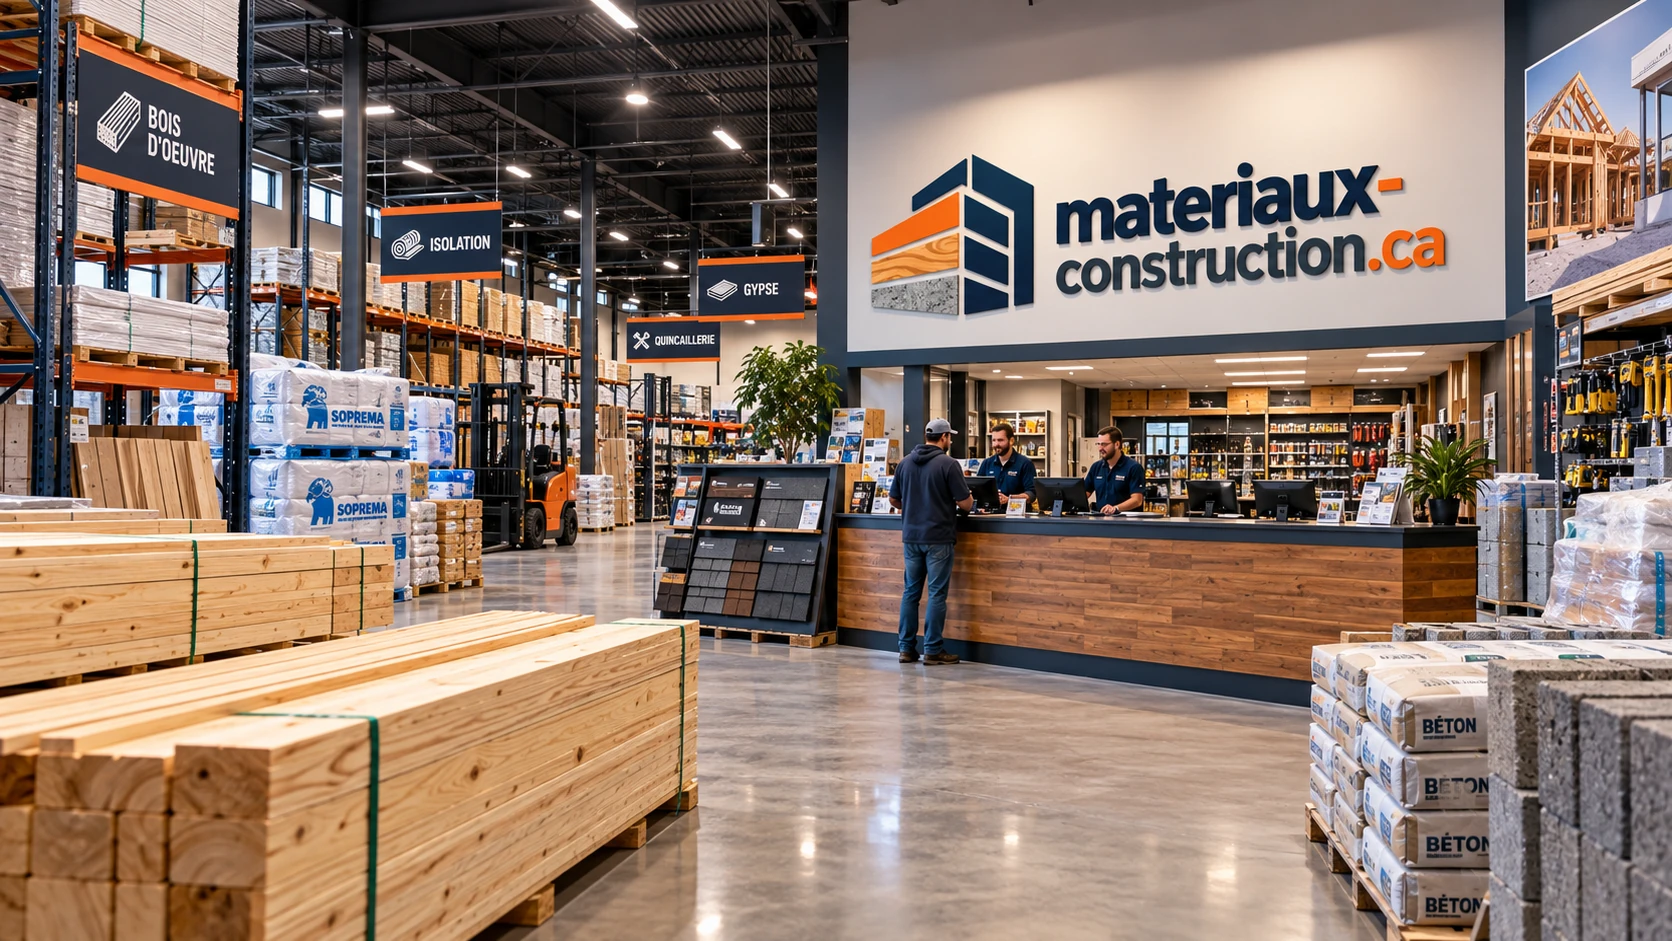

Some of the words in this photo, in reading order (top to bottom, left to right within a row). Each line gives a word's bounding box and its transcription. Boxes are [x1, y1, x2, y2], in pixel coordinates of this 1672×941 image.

[148, 104, 181, 138] BOIS
[147, 132, 215, 176] D'OEUVRE
[1056, 161, 1404, 245] materiaux-
[430, 235, 490, 252] ISOLATION
[1055, 226, 1446, 295] construction.ca
[743, 282, 779, 296] GYPSE
[654, 334, 715, 346] QUINCAILLERIE
[331, 409, 385, 424] SOPREMA
[337, 501, 388, 516] SOPREMA
[1422, 715, 1477, 734] BÉTON
[1426, 832, 1490, 852] BÉTON
[1425, 894, 1484, 914] BÉTON
